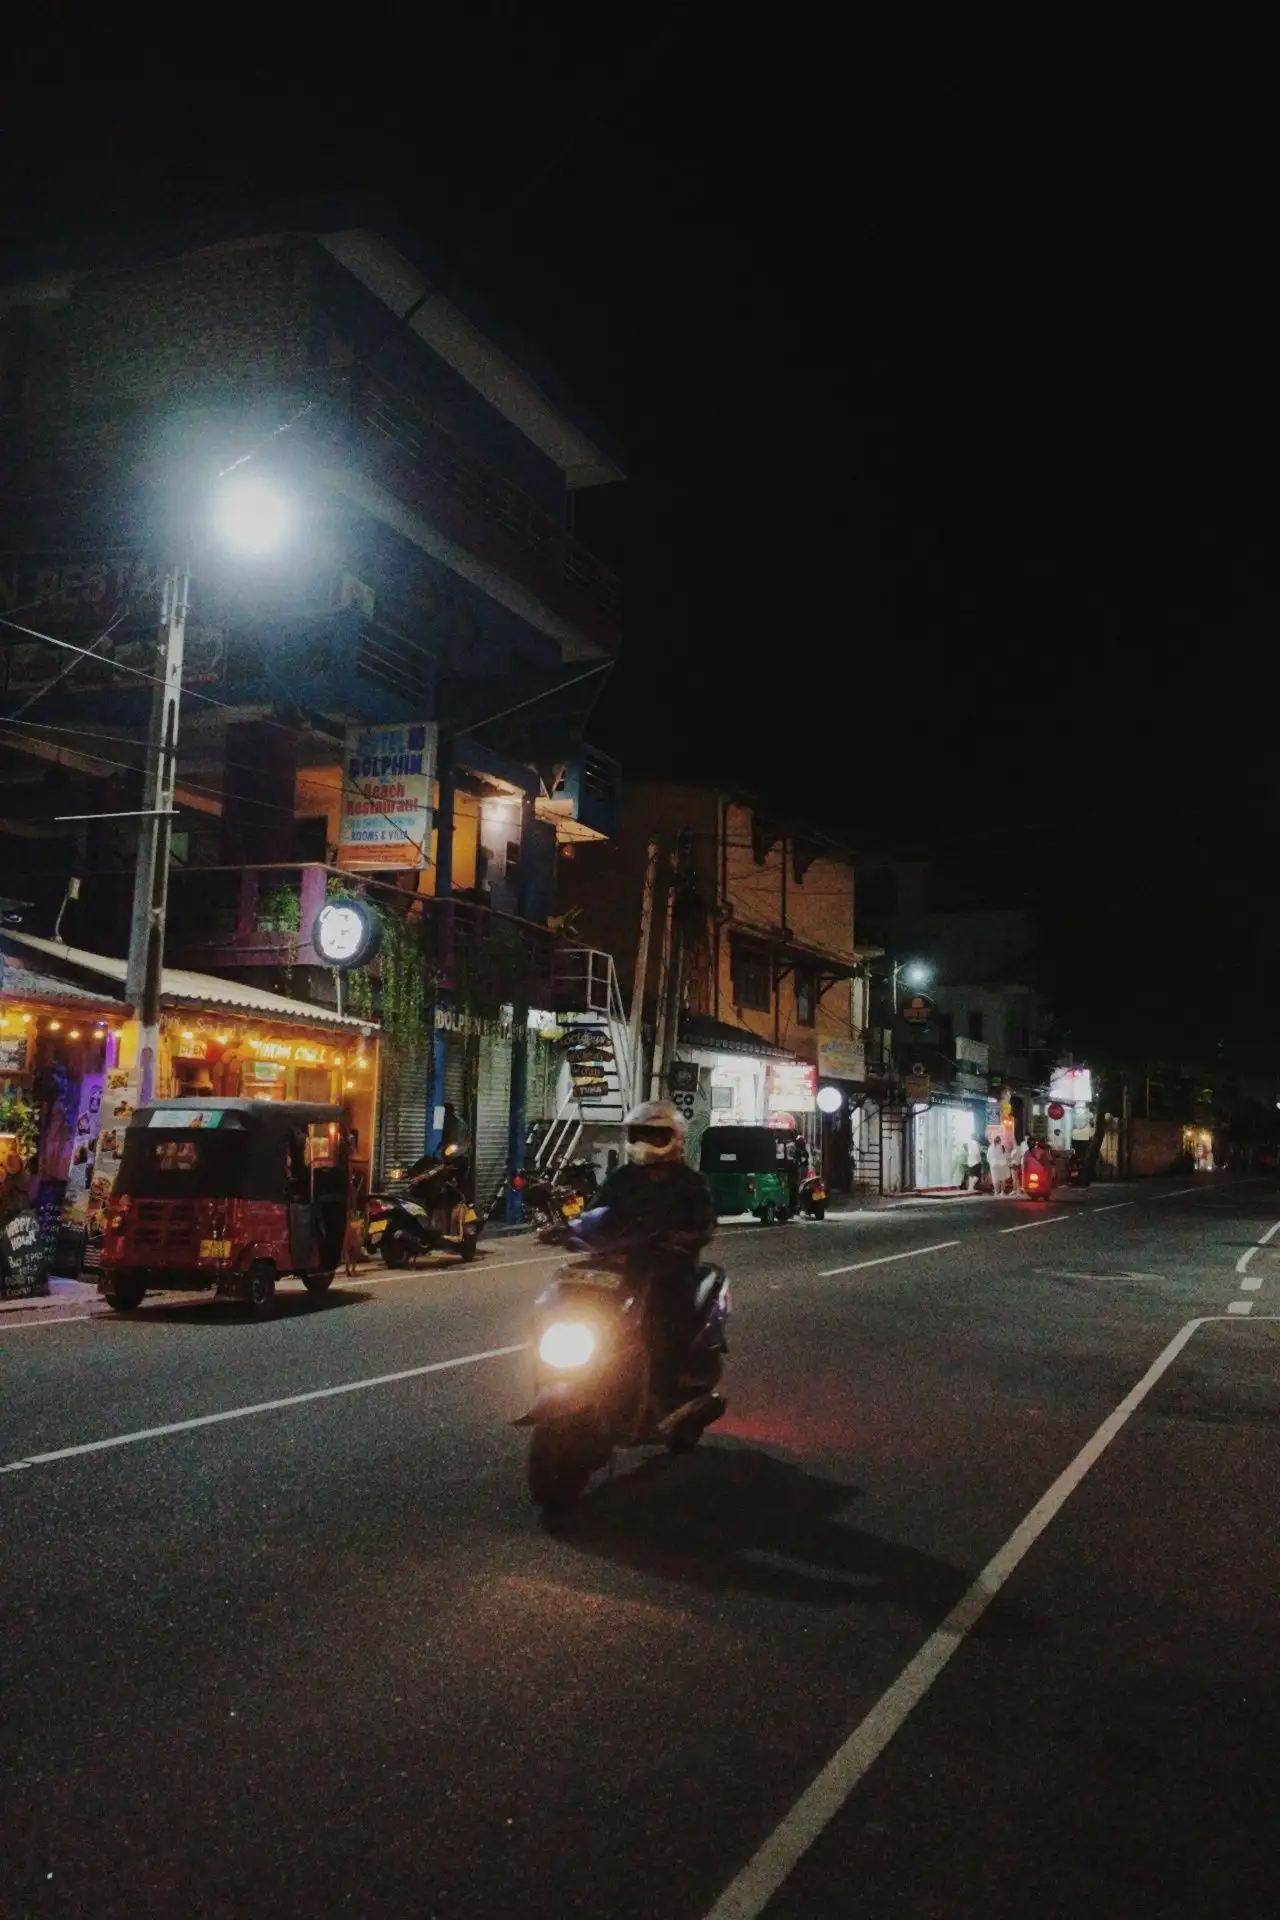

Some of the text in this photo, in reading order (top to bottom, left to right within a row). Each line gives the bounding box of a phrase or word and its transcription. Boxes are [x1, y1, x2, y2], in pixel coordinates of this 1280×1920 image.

[349, 755, 422, 778] DOLPHIN
[364, 784, 405, 800] Beach
[346, 798, 418, 816] Restaurant
[352, 831, 379, 841] ROOMS
